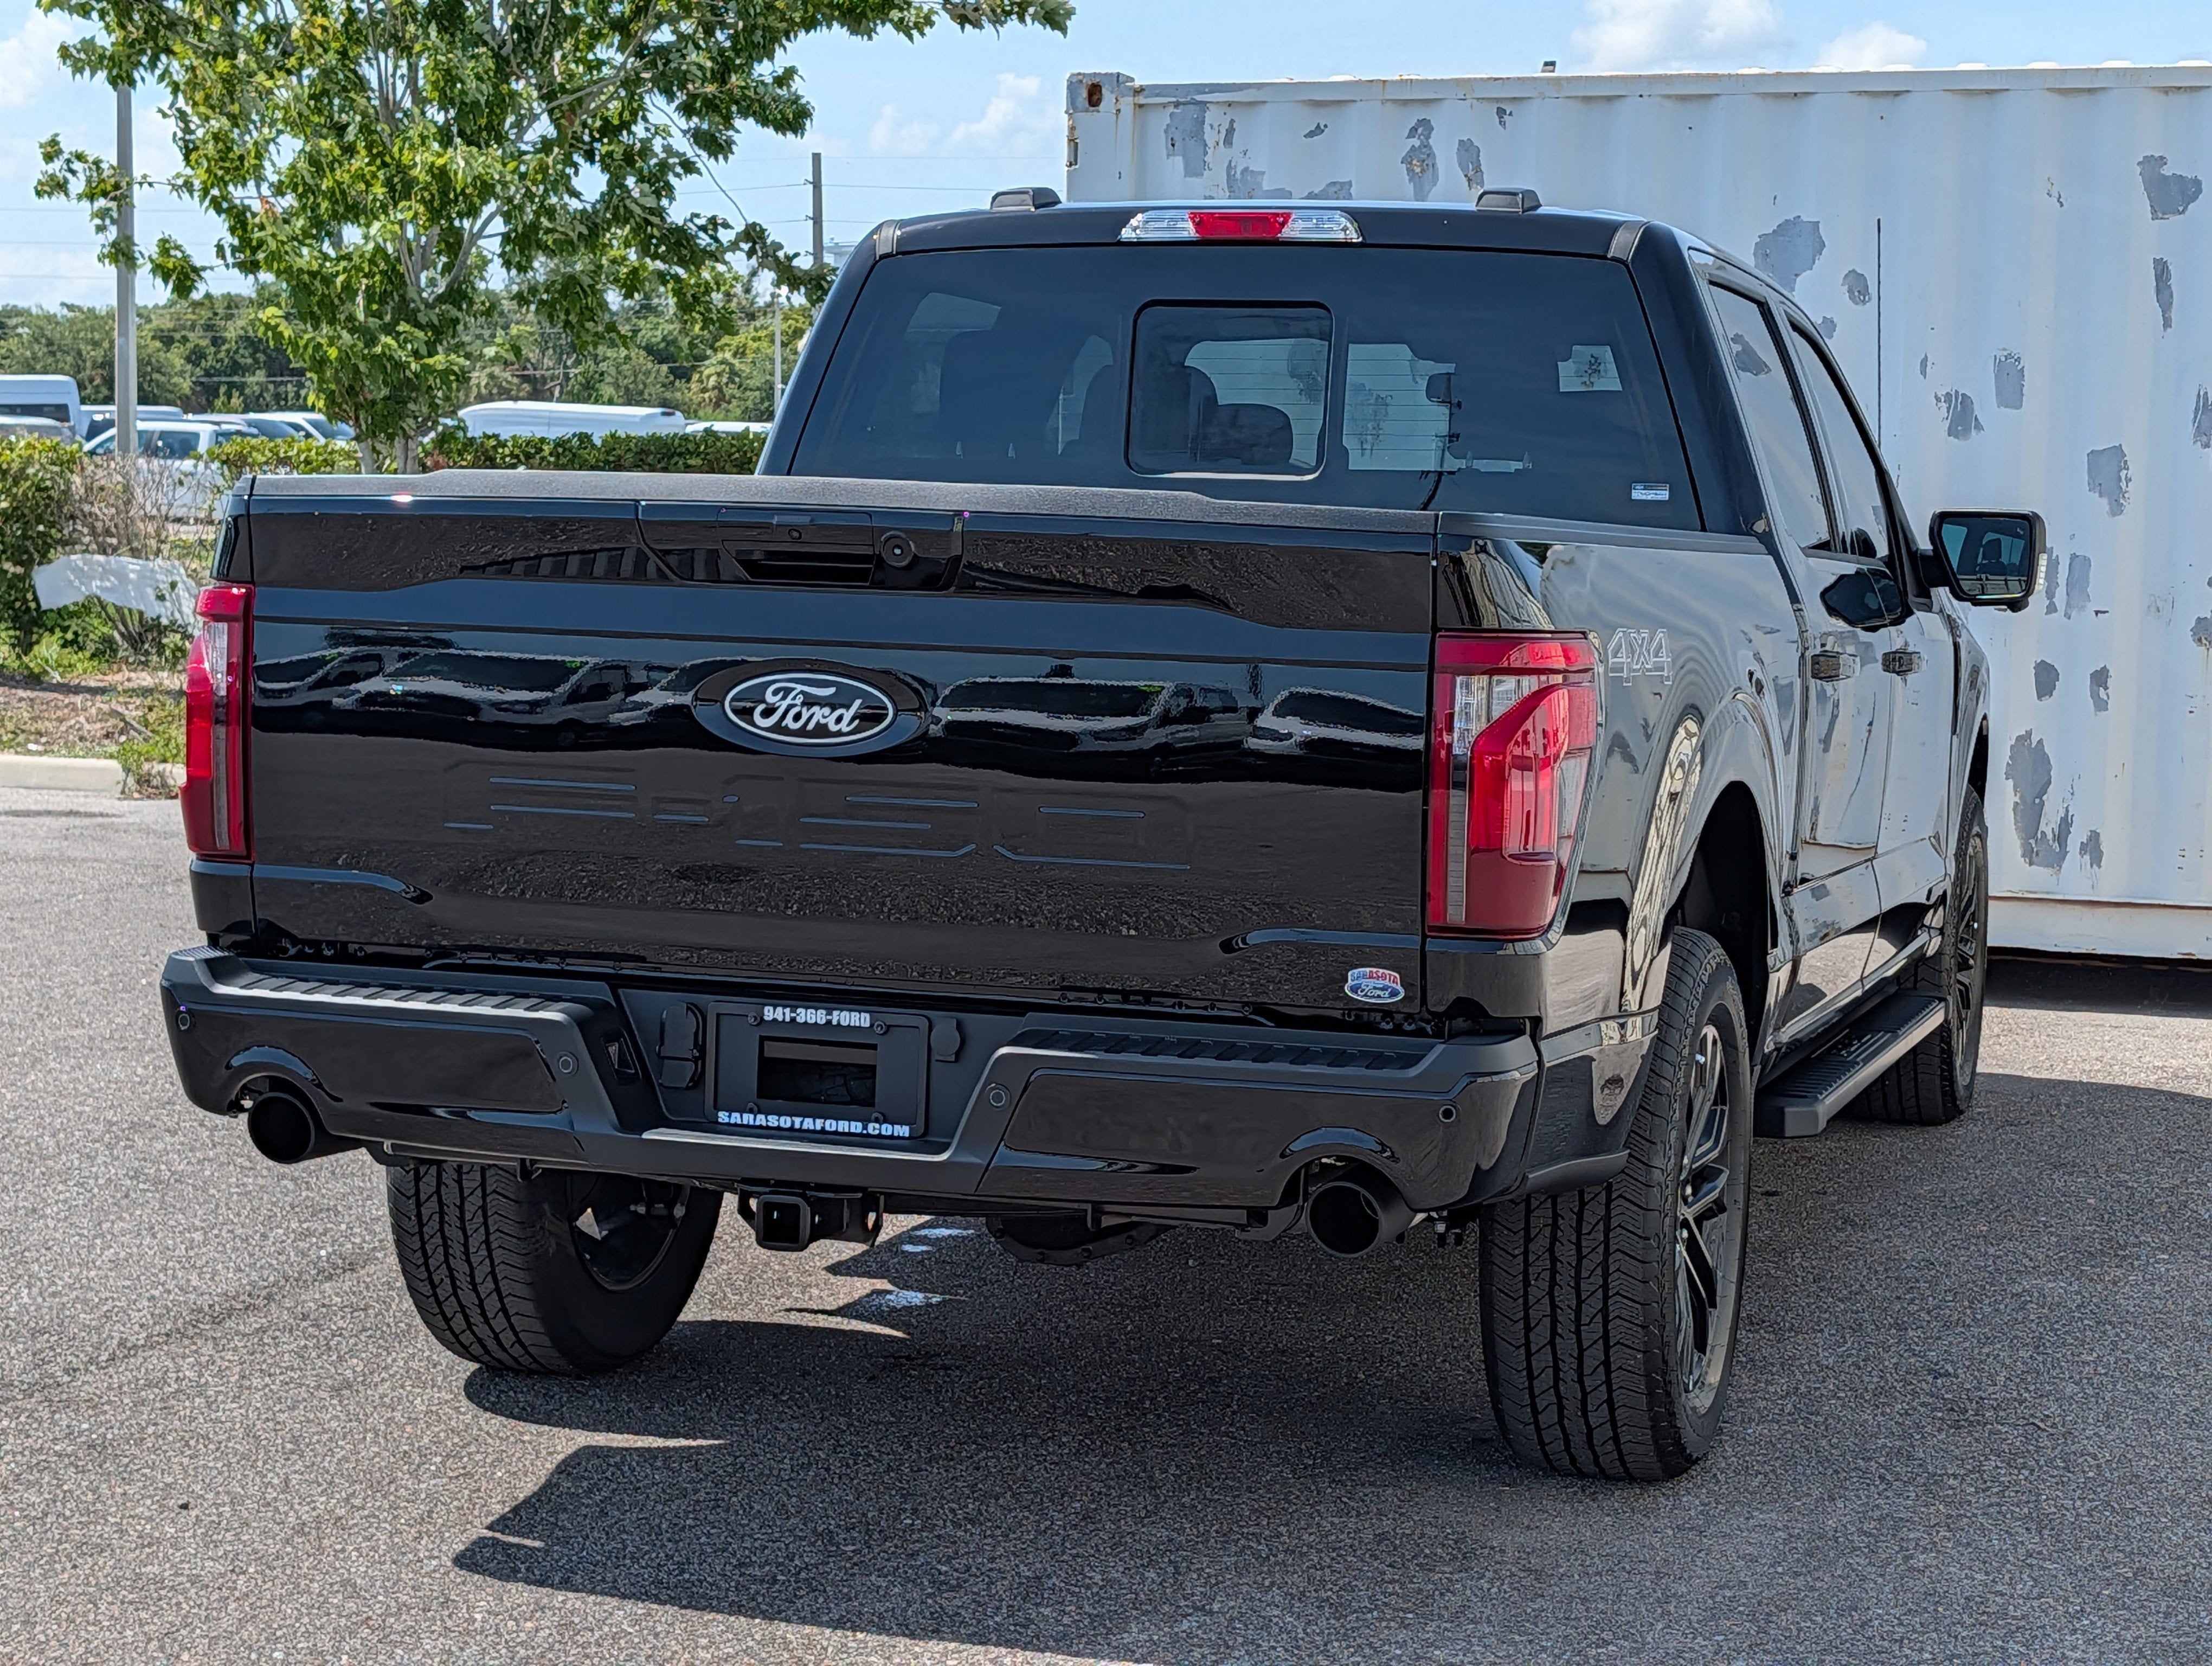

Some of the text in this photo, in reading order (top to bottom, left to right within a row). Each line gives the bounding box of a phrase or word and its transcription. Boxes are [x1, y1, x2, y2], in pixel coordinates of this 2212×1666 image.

[753, 682, 863, 733] Ford
[1358, 982, 1392, 997] Ford
[763, 1005, 871, 1028] 941-366-FORD
[717, 1111, 910, 1138] SARASOTAFORD.COM
